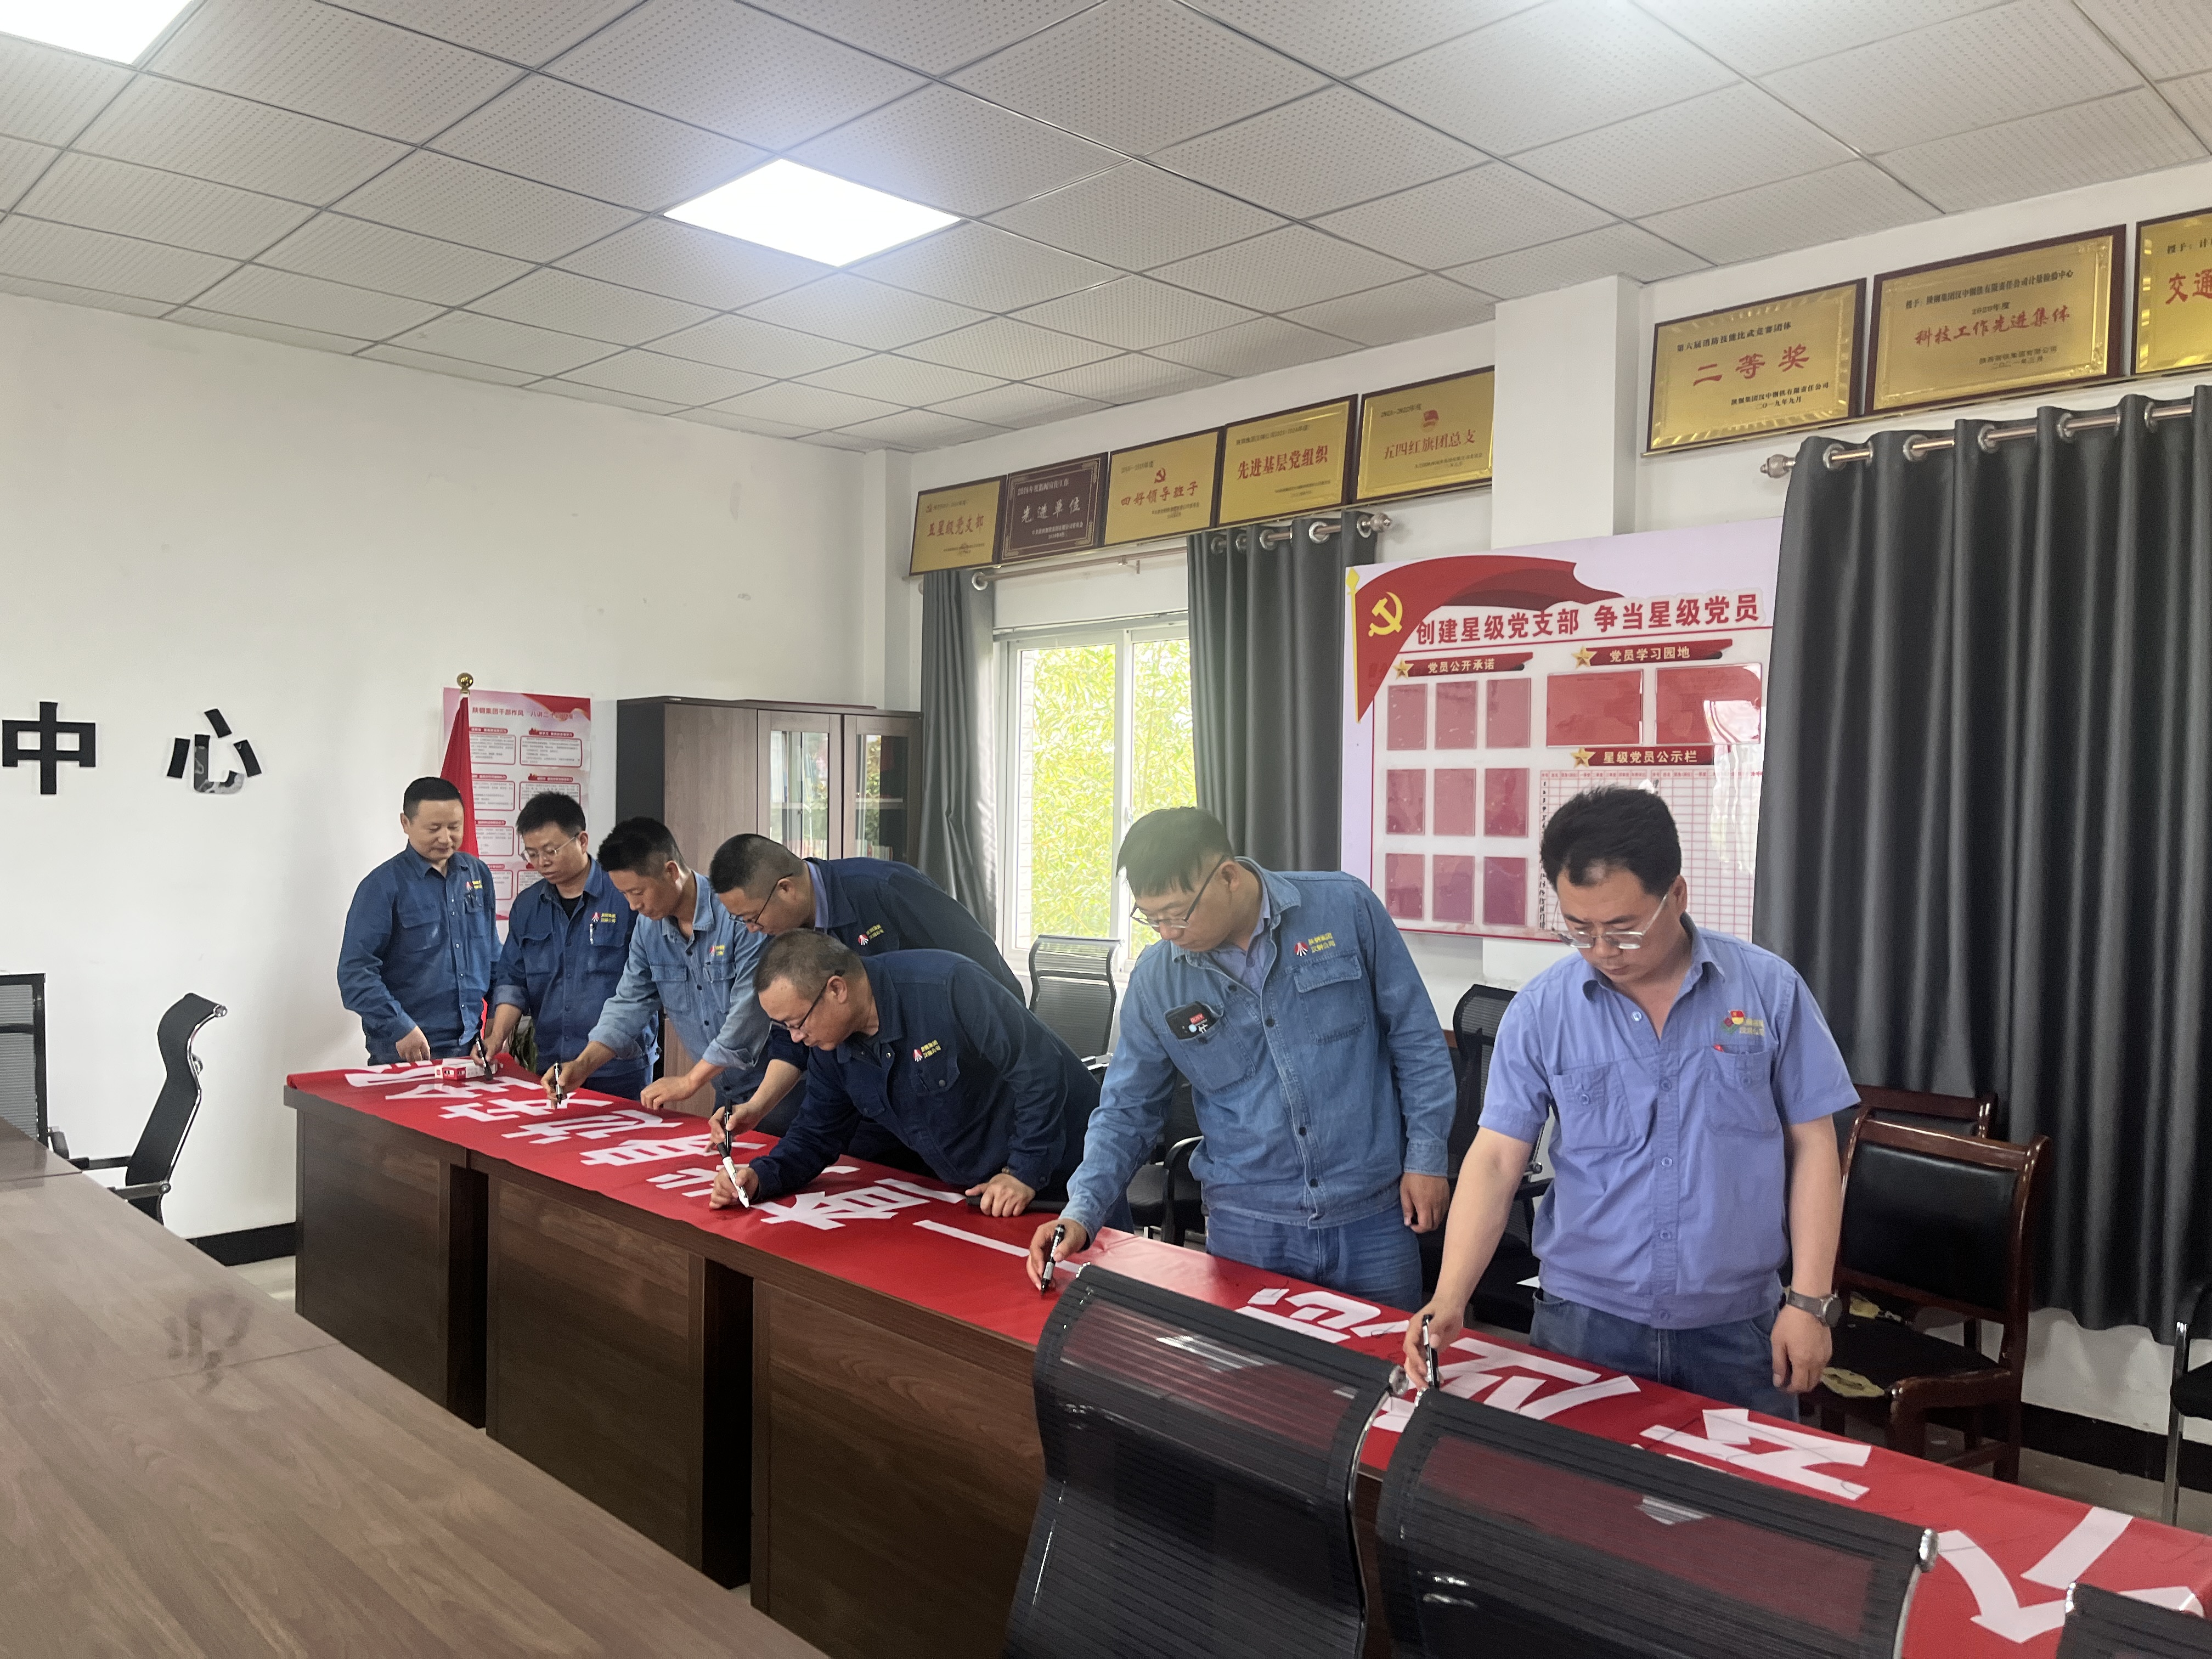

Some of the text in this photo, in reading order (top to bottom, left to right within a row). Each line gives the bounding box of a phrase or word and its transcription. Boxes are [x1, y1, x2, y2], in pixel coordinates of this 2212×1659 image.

[2166, 268, 2212, 304] 交通
[1914, 304, 2070, 347] 科技工作先进集体
[1693, 343, 1809, 386] 二等奖
[1385, 429, 1476, 459] 五四红旗团总支
[1237, 445, 1328, 480] 先进基层党组织
[1121, 481, 1198, 506] 四好领导班子
[1021, 496, 1080, 523] 先进单位
[927, 513, 984, 537] 五星级党支部
[1417, 594, 1759, 645] 创建星级党支部 争当星级党员
[1427, 658, 1495, 674] 党员公开承诺
[1610, 646, 1690, 663] 党员学习园地
[472, 707, 524, 717] 陕钢集团干部作风
[2, 701, 262, 795] 中心
[1603, 749, 1698, 764] 星级党员公示栏
